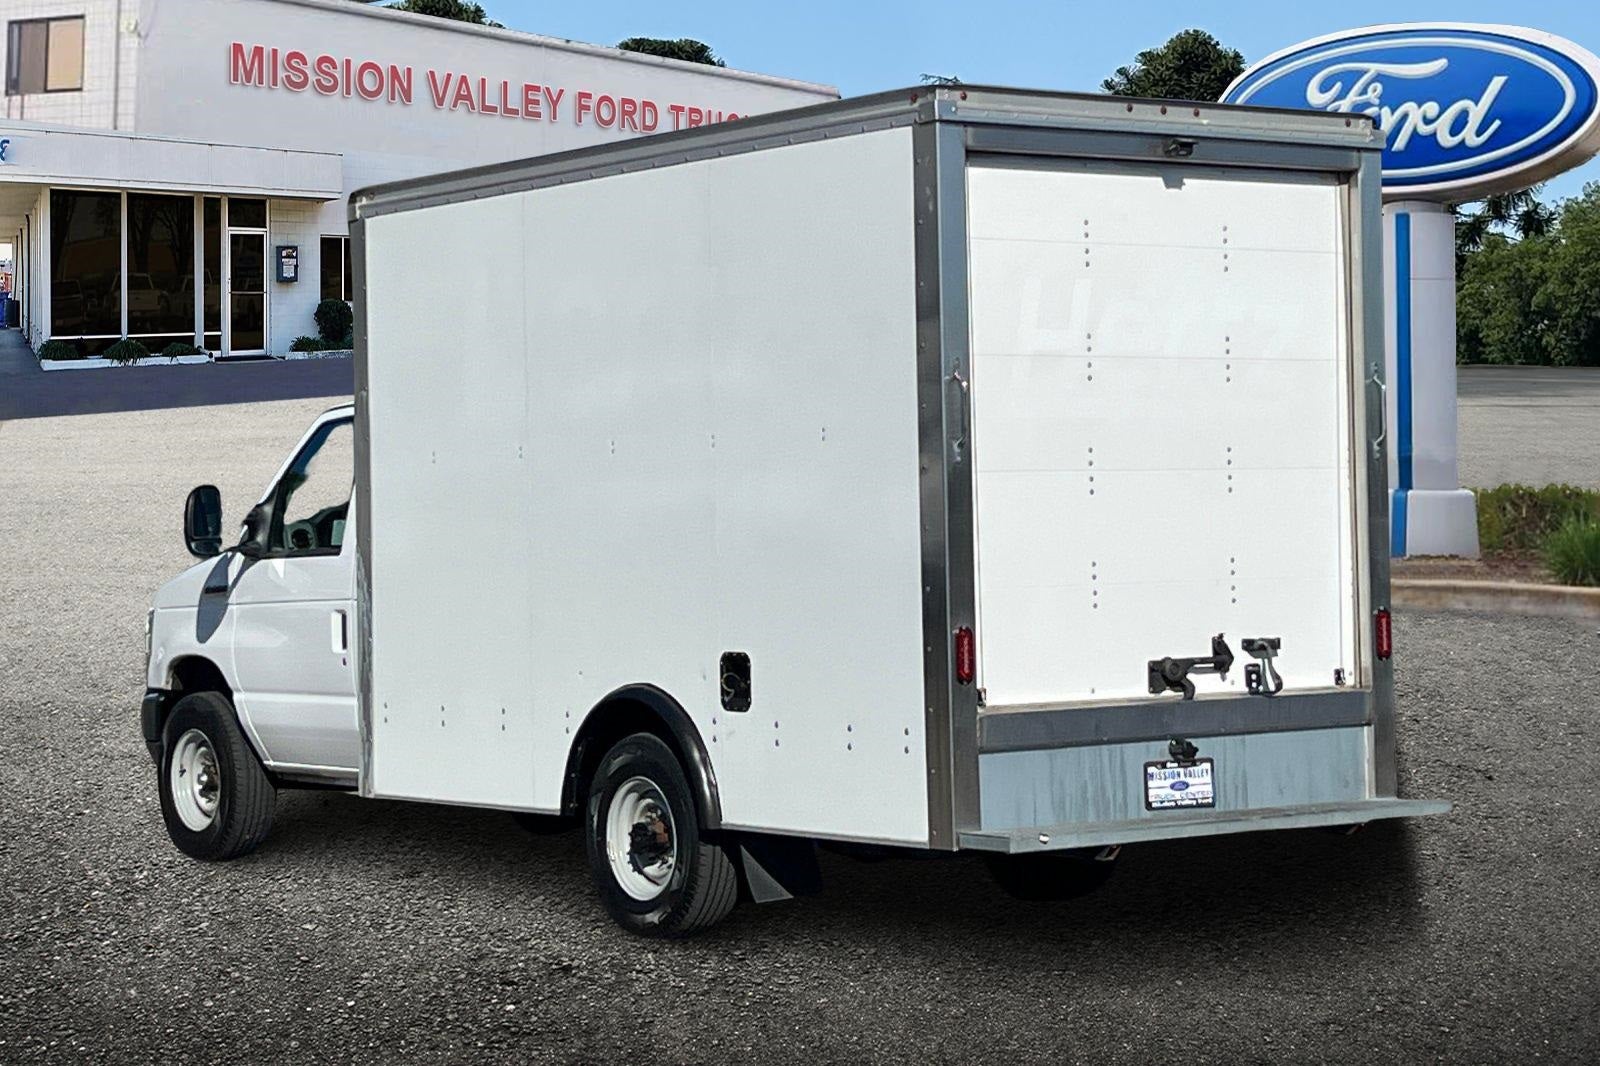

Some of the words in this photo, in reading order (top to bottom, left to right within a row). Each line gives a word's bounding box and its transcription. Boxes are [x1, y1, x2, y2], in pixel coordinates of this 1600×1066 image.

[230, 42, 413, 104] MISSION
[427, 70, 565, 122] VALLEY
[576, 90, 659, 133] FORD
[1147, 770, 1181, 781] MISSION
[1183, 768, 1209, 779] VALLEY
